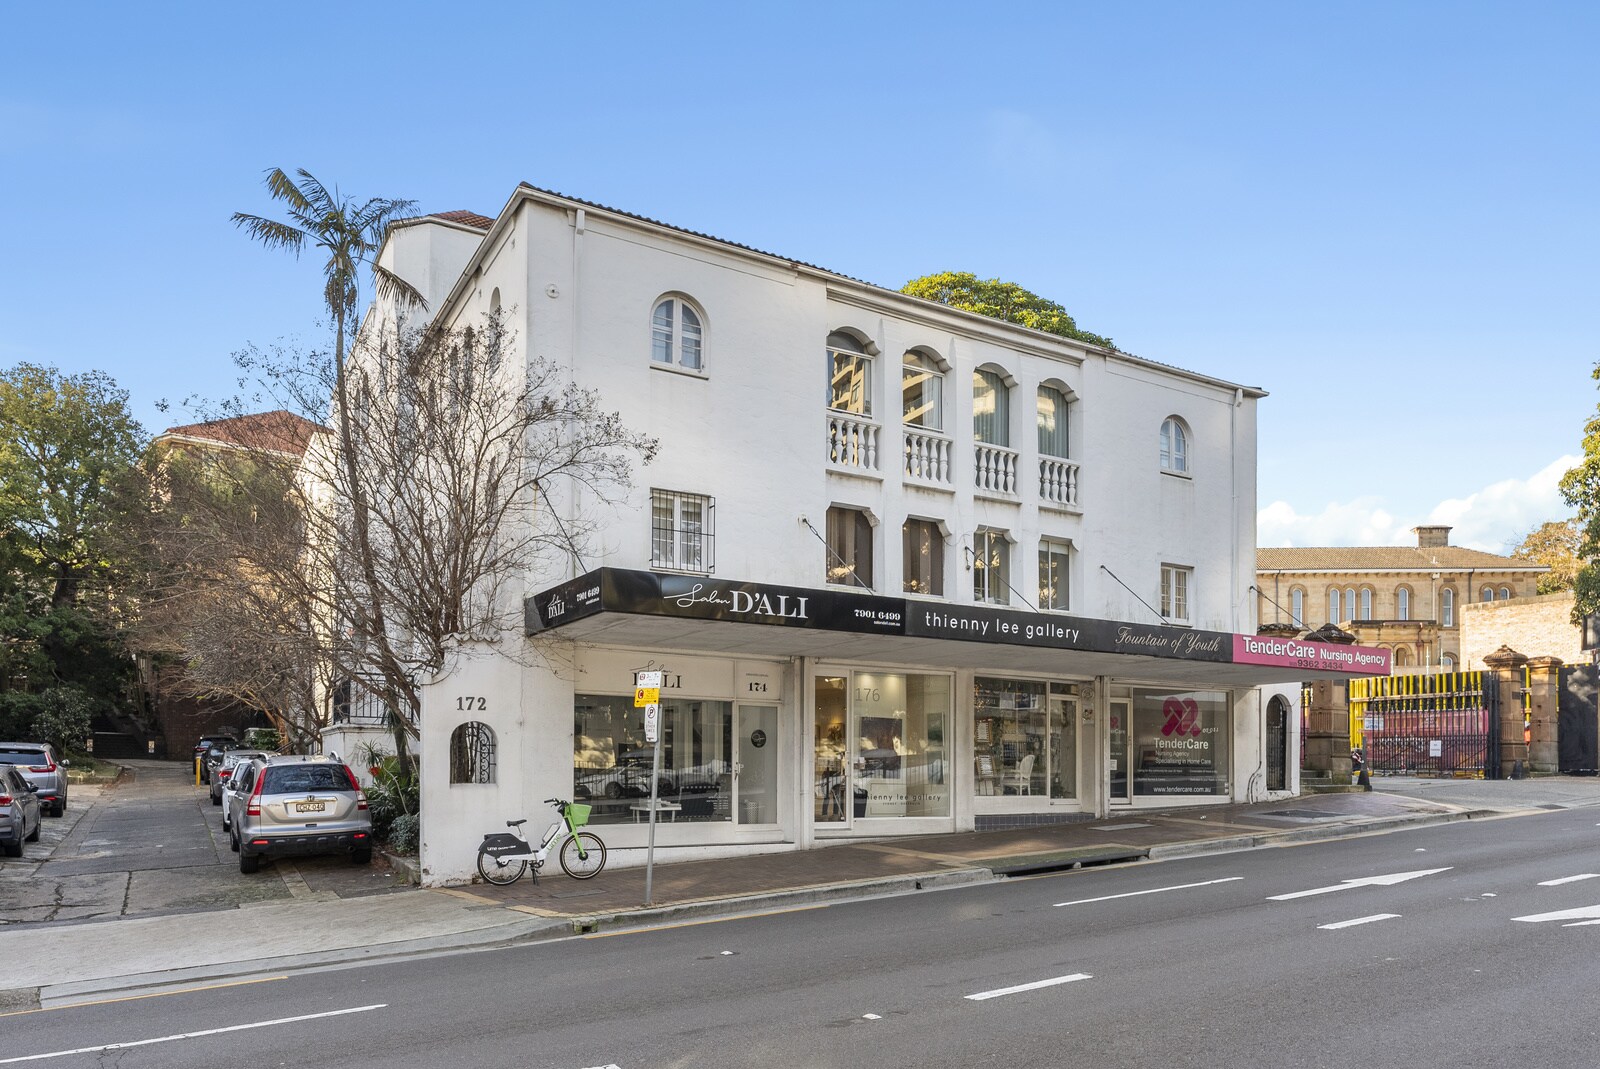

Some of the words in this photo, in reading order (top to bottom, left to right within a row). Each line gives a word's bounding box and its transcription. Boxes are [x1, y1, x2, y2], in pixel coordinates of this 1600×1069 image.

[729, 590, 809, 619] D'ALI
[854, 609, 876, 619] 7901
[878, 611, 901, 621] 6499
[925, 611, 989, 636] thienny
[996, 618, 1019, 634] lee
[1026, 623, 1080, 644] gallery
[1115, 626, 1168, 647] Fountain
[1170, 632, 1187, 654] of
[1185, 632, 1221, 654] Youth
[1242, 636, 1316, 659] TenderCare
[1320, 648, 1353, 664] Nursing
[1354, 652, 1386, 667] Agency
[1297, 659, 1320, 669] 9362
[1322, 661, 1344, 670] 3434
[748, 682, 768, 693] 174
[855, 687, 881, 702] 176
[456, 696, 487, 711] 172
[1153, 737, 1209, 750] TenderCare
[1173, 750, 1190, 758] Agency
[912, 793, 941, 802] gallery
